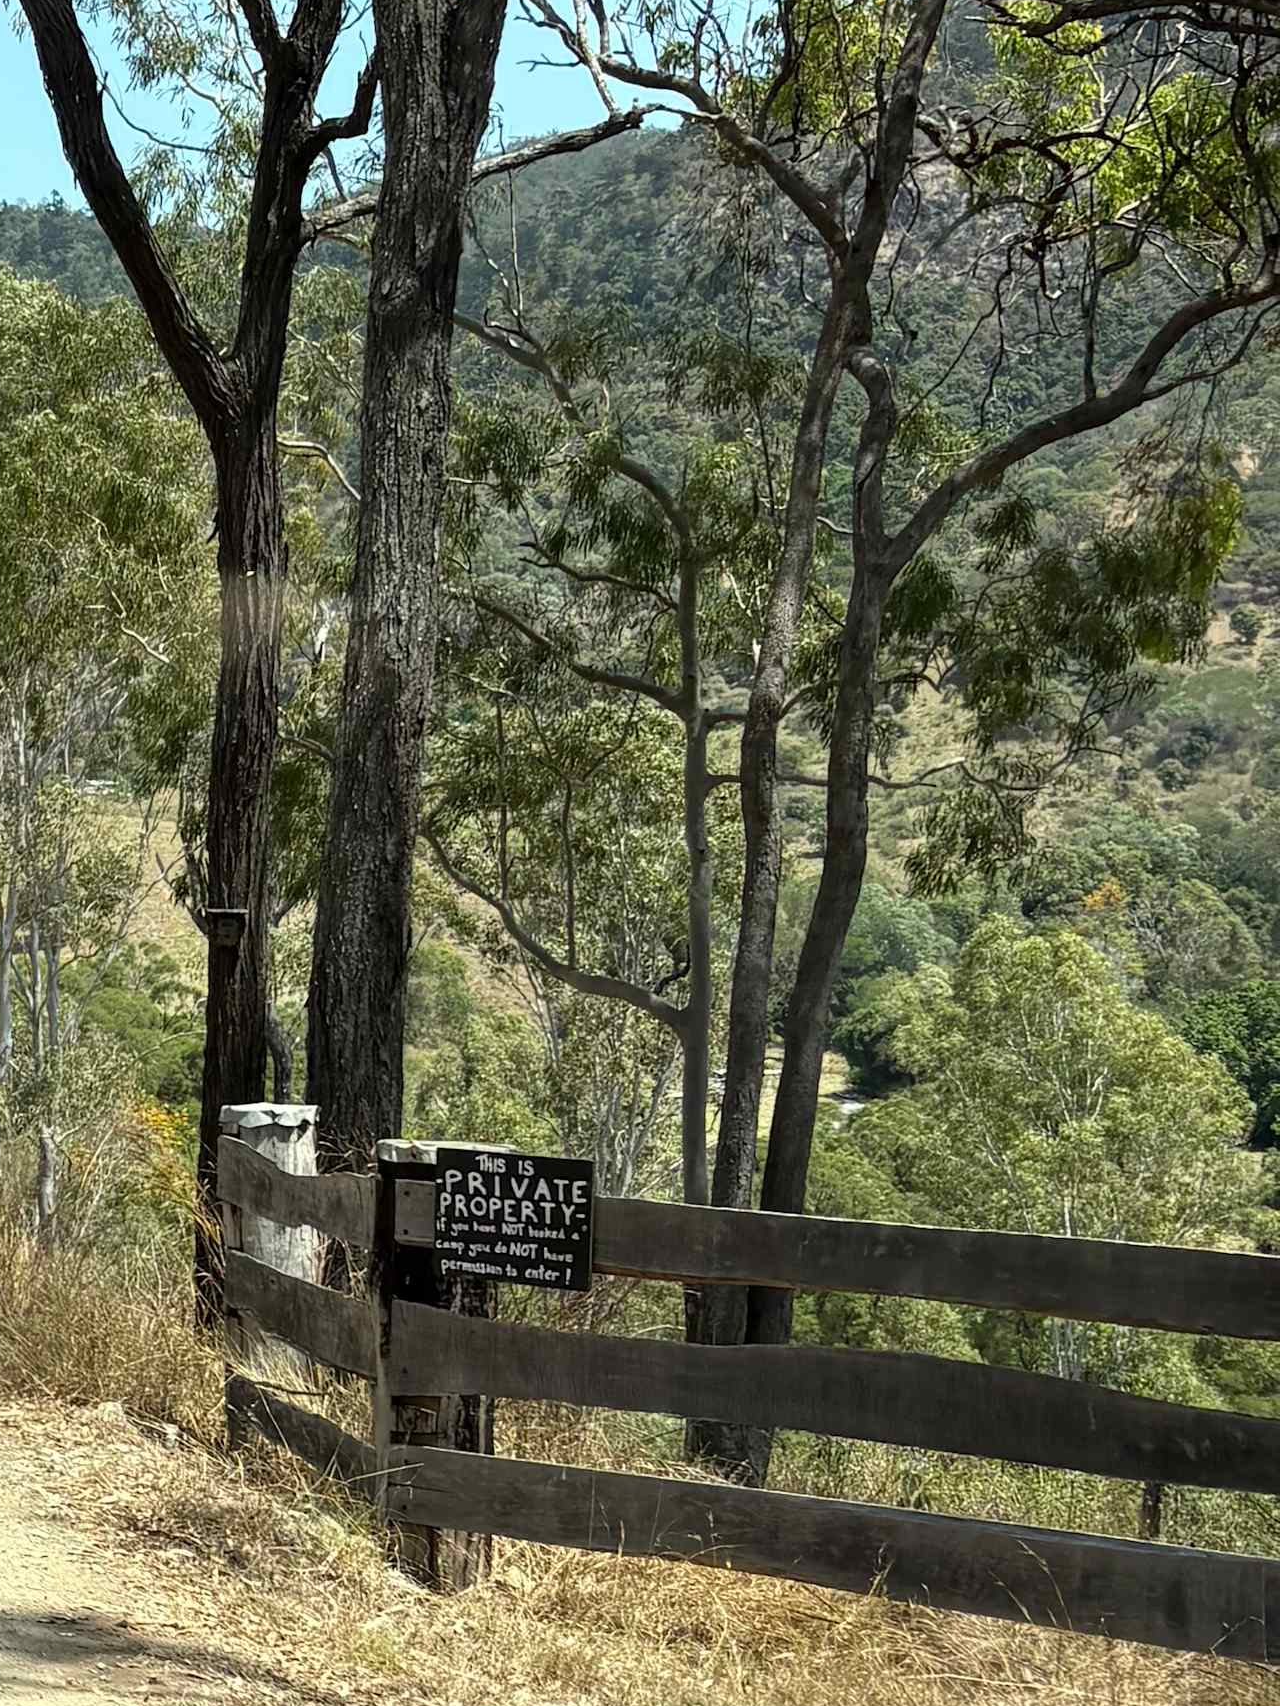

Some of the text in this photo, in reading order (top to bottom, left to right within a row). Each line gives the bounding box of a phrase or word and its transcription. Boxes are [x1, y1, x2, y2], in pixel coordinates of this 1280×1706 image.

[475, 1154, 535, 1177] THIS IS
[450, 1221, 469, 1236] you
[473, 1221, 496, 1233] have
[502, 1222, 525, 1236] NOT
[571, 1232, 580, 1240] a
[468, 1243, 490, 1257] you
[494, 1241, 507, 1254] do
[509, 1242, 538, 1259] NOT
[543, 1246, 574, 1263] have
[441, 1258, 503, 1275] permission
[505, 1263, 518, 1278] to
